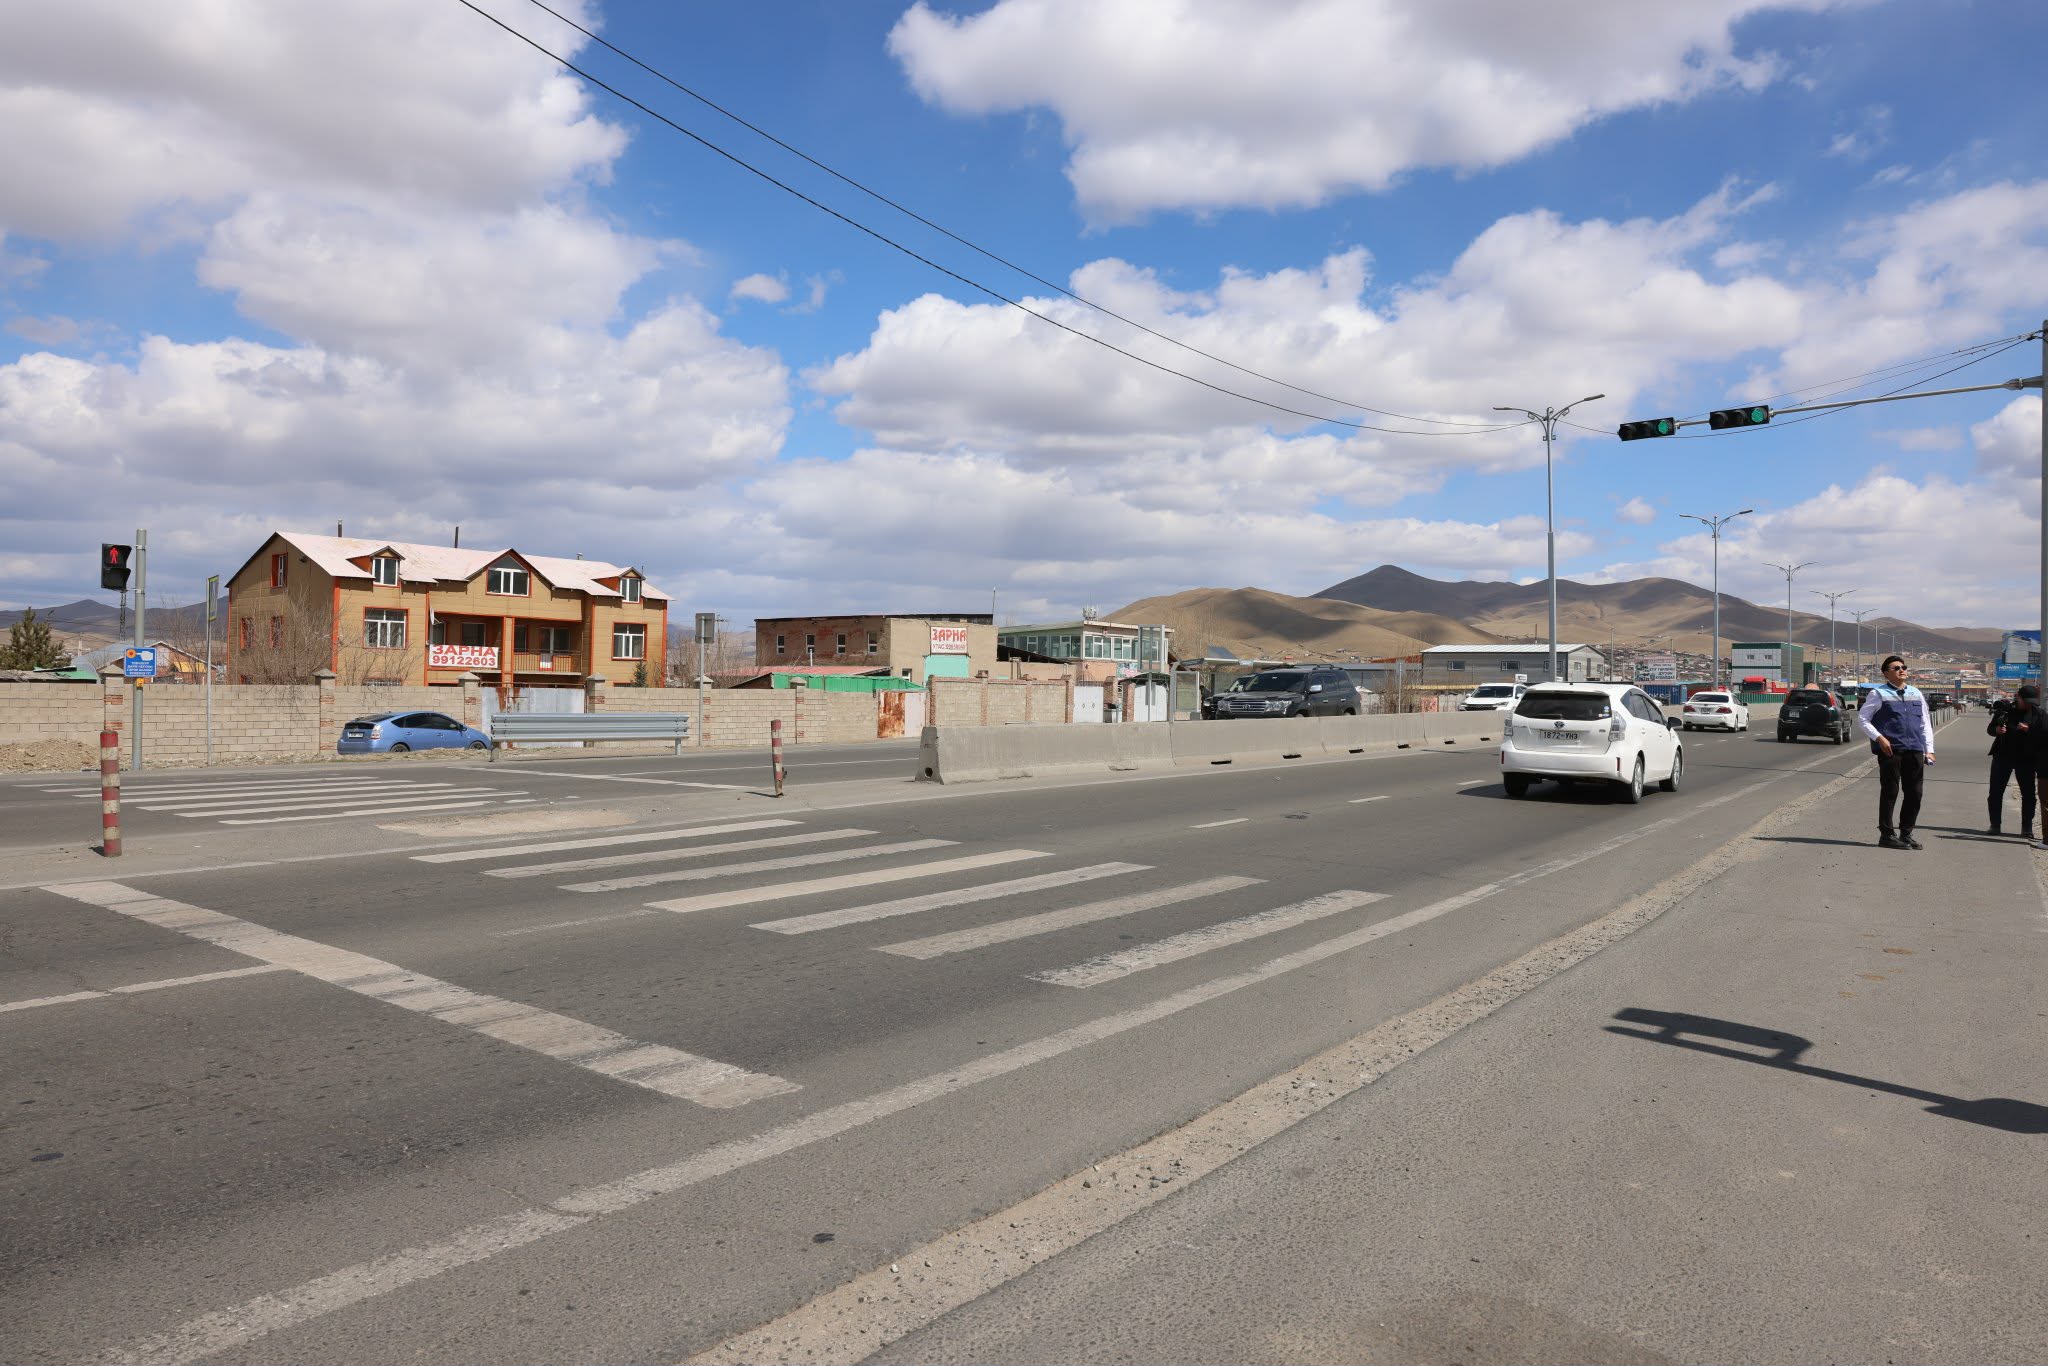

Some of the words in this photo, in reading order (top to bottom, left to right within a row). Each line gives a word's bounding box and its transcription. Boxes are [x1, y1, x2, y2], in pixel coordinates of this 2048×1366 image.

[931, 628, 966, 642] ЗАРНА
[432, 644, 496, 657] ЗАРНА
[432, 655, 496, 666] 99122603
[1543, 731, 1561, 740] 1872
